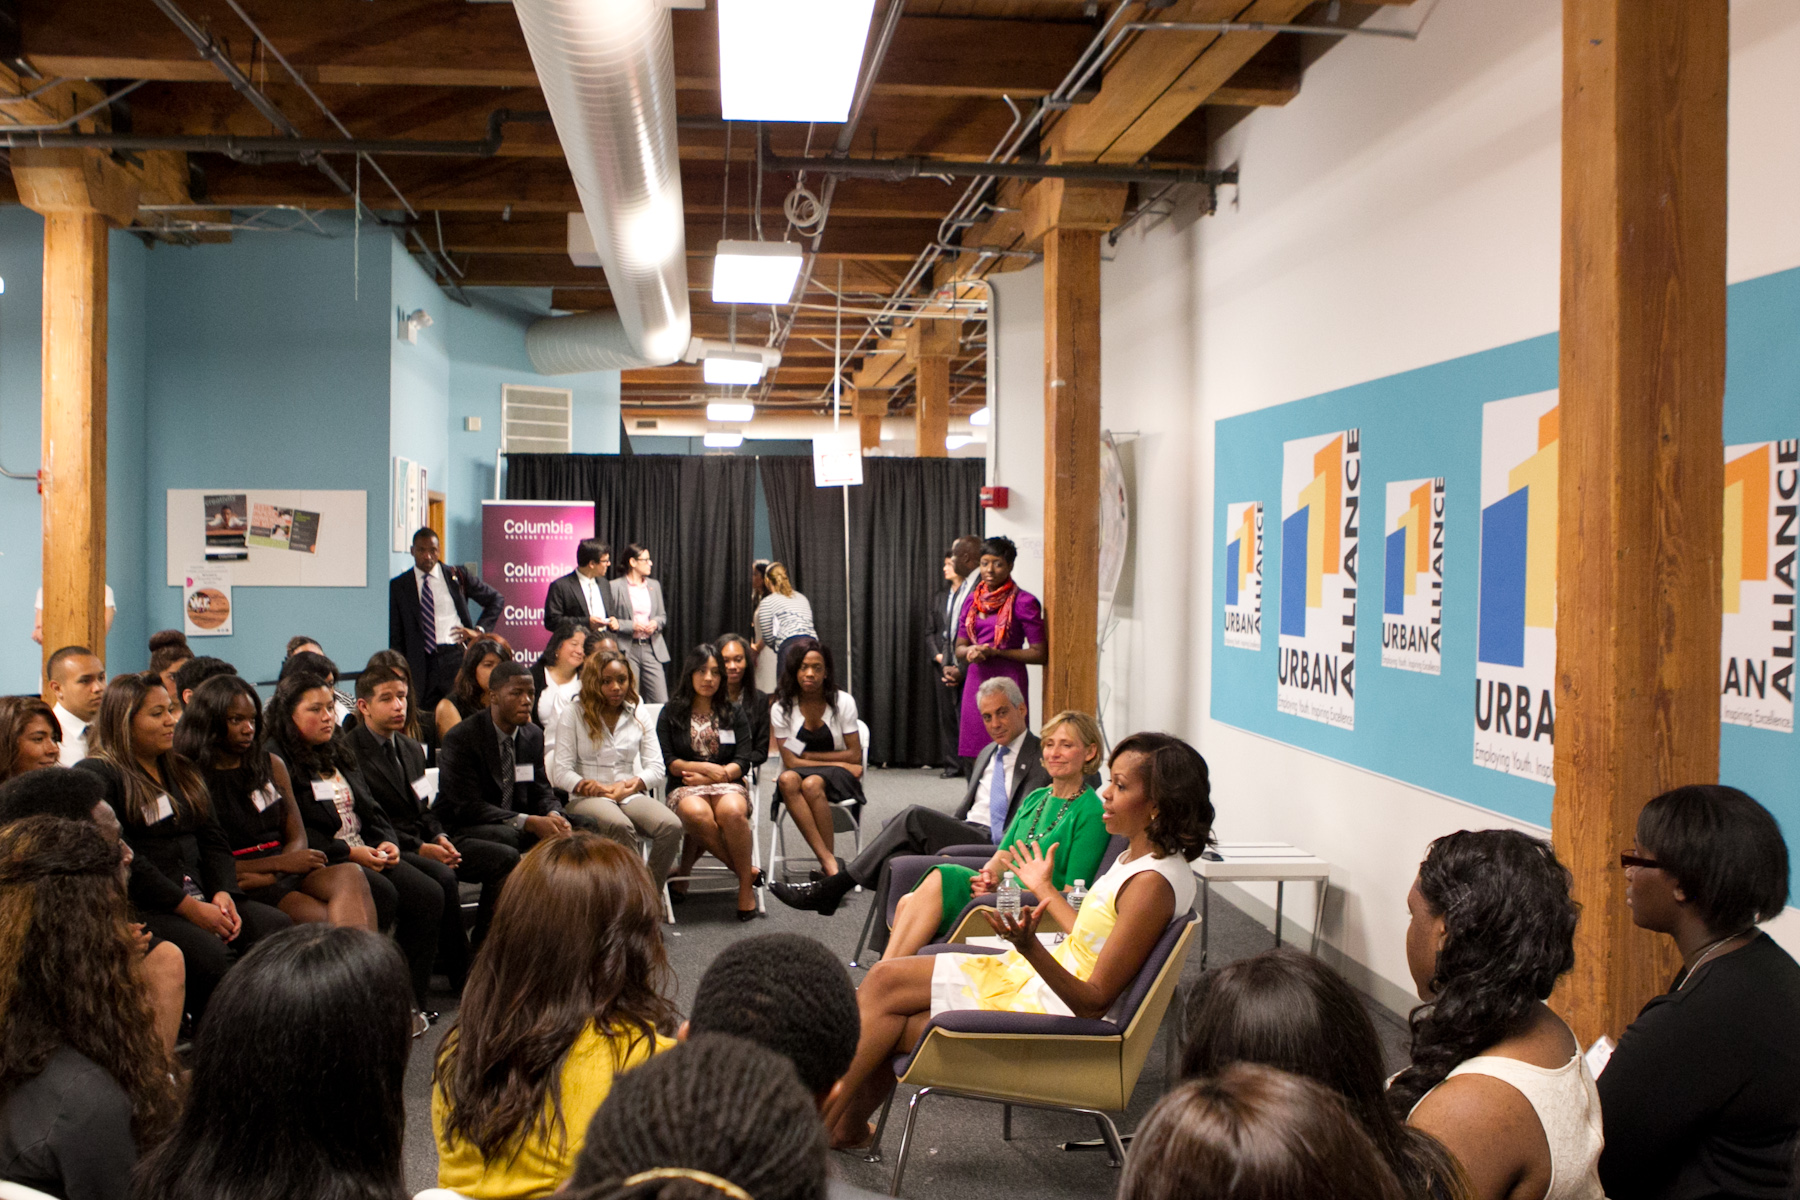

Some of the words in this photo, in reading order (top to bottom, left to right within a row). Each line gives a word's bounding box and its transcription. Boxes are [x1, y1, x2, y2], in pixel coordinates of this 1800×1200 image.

[503, 519, 574, 534] Columbia
[1255, 502, 1264, 635] ALLIANCE
[1341, 428, 1360, 699] ALLIANCE
[1431, 477, 1445, 654] ALLIANCE
[1772, 438, 1799, 702] ALLIANCE
[1224, 612, 1254, 635] URBAN
[1382, 622, 1429, 654] URBAN
[1278, 646, 1338, 696] URBAN
[1475, 678, 1554, 745] URBA
[1475, 742, 1510, 773] Employing
